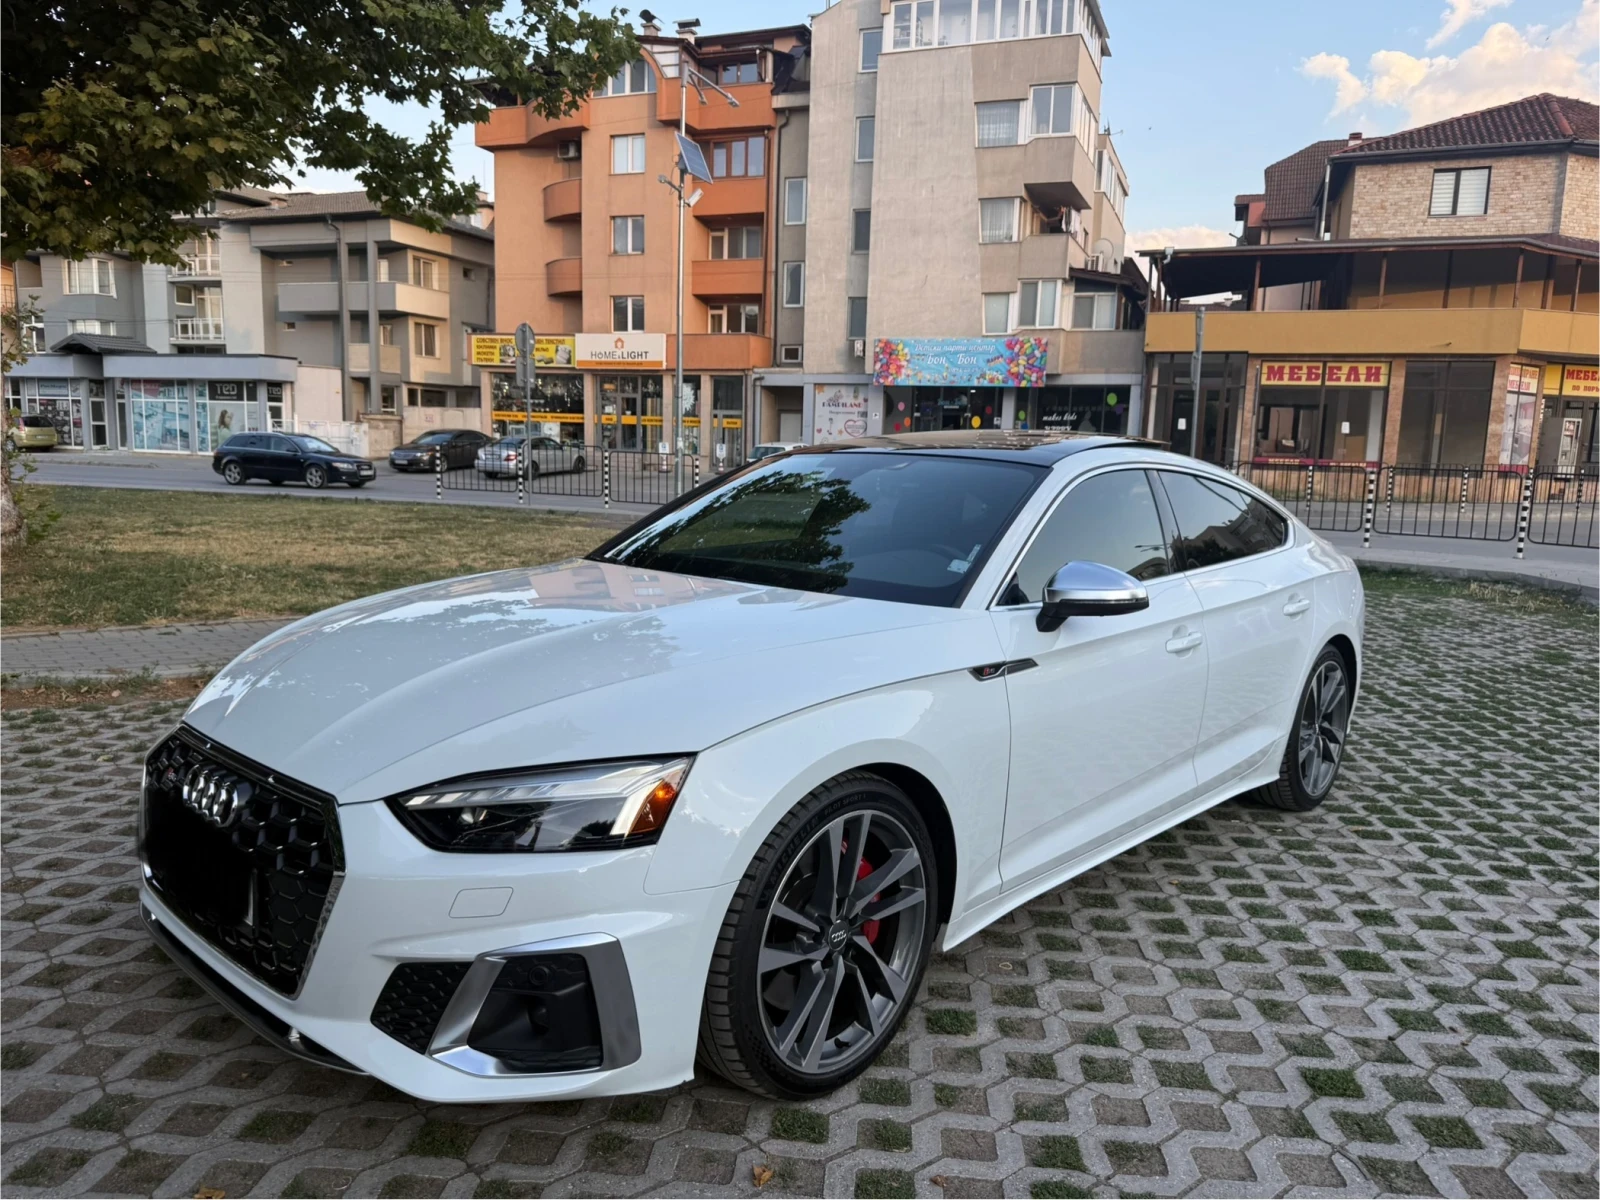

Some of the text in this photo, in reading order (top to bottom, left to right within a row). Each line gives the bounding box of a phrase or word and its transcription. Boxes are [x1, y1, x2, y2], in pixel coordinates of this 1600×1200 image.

[943, 344, 968, 354] парти
[927, 353, 946, 365] Бон
[956, 353, 977, 365] Бон
[1265, 365, 1382, 382] МЕБЕЛИ
[1565, 369, 1599, 381] МЕБЕ
[1063, 412, 1077, 421] kids
